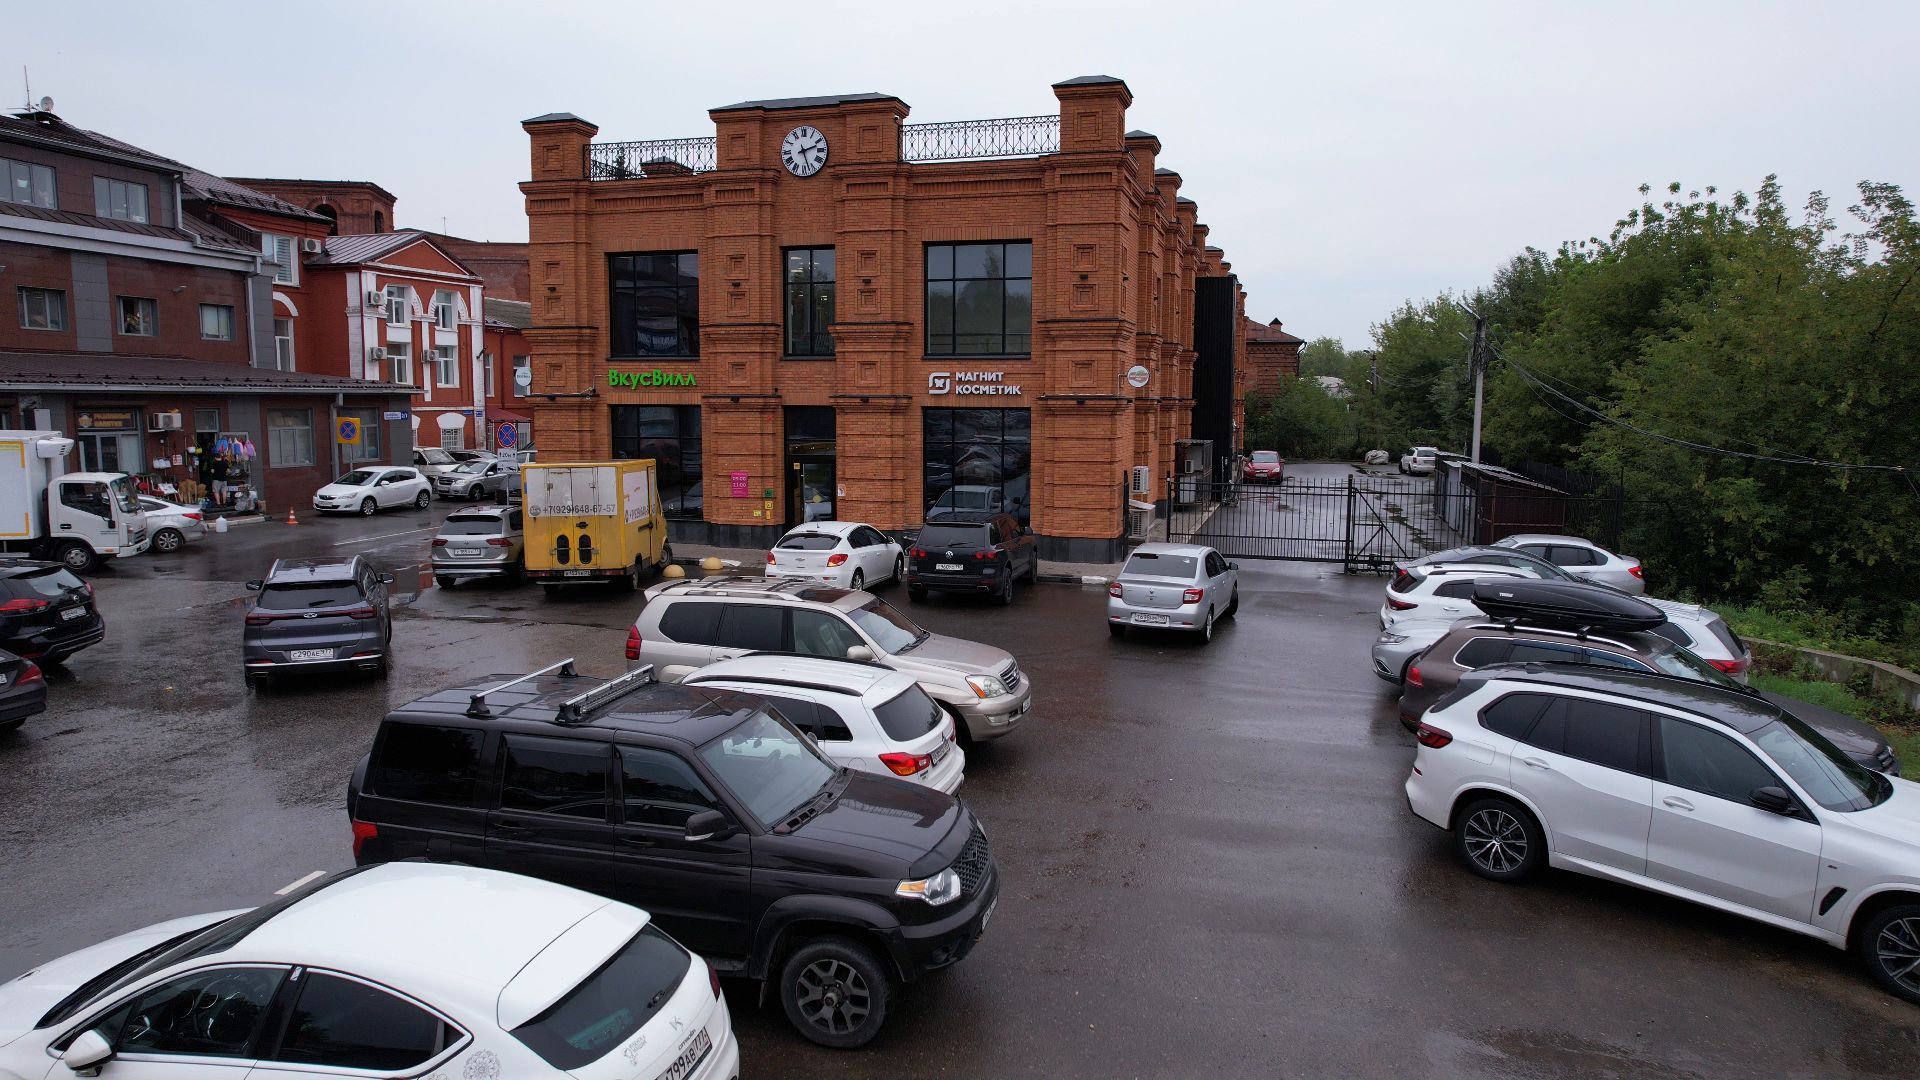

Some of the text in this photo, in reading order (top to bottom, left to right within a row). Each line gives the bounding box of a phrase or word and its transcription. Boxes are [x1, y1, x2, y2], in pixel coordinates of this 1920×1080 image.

[608, 369, 697, 390] ВкусВилл
[955, 371, 1004, 382] МАГНИТ
[955, 385, 1022, 395] КОСМЕТИК
[543, 503, 616, 515] +7(929)648-67-57
